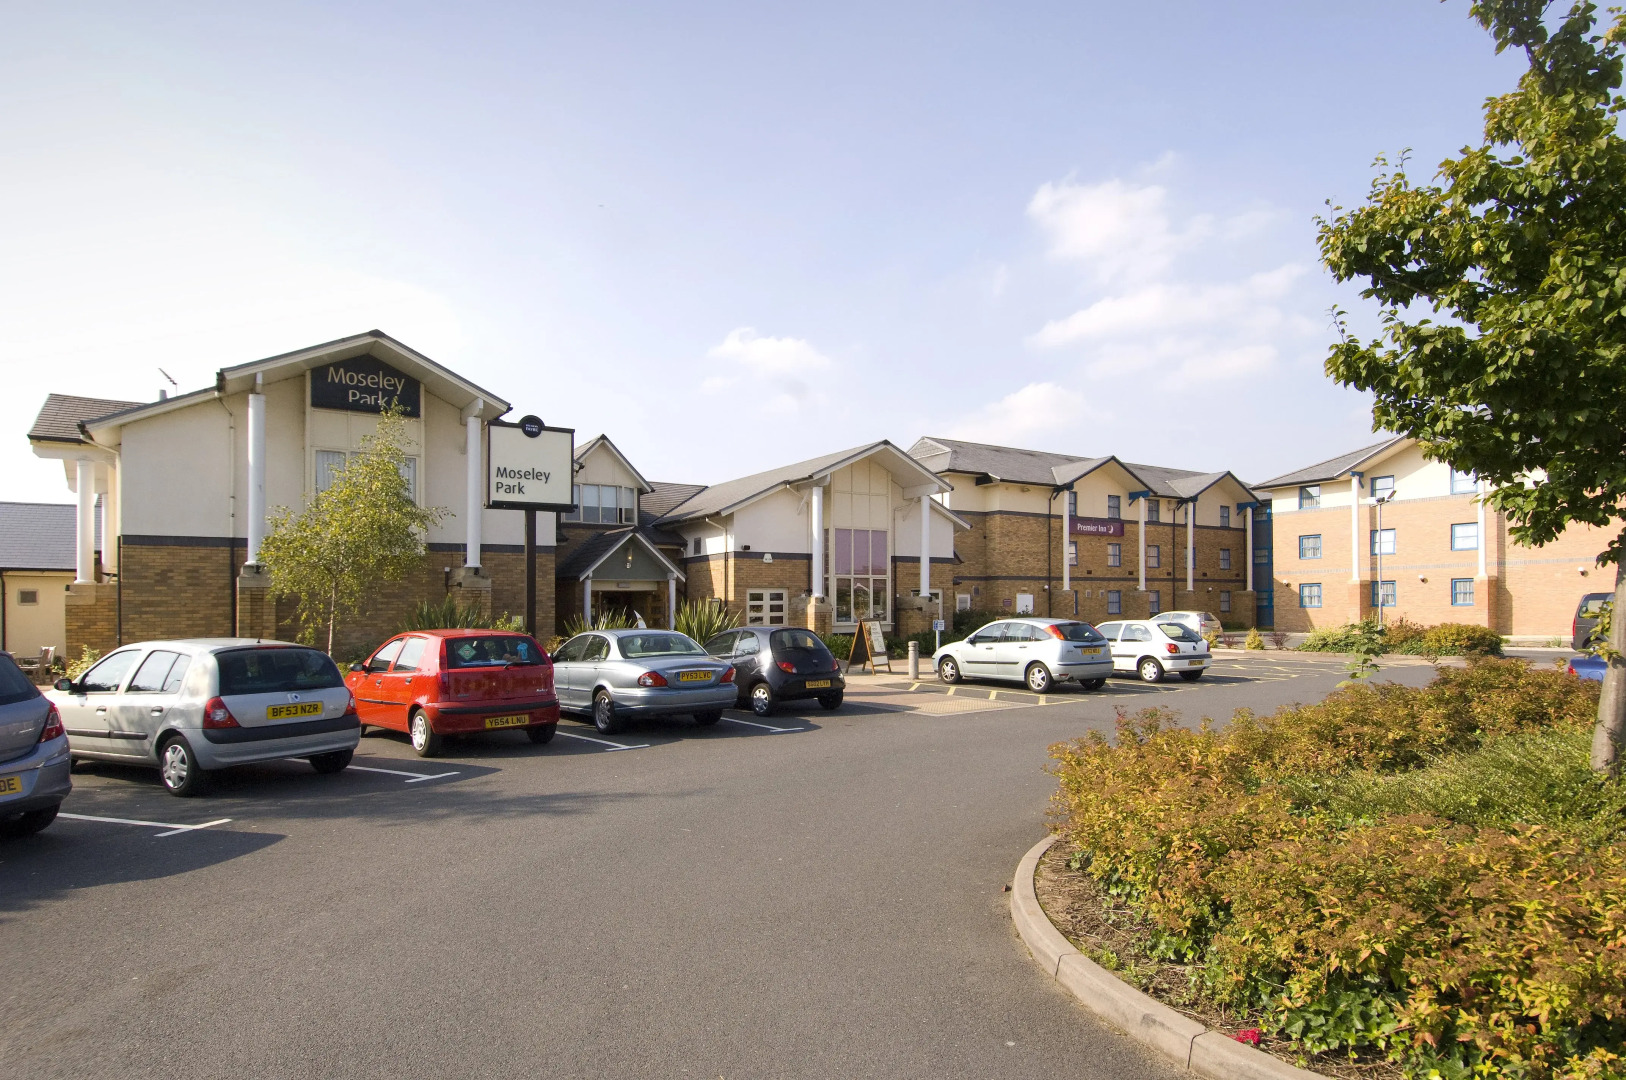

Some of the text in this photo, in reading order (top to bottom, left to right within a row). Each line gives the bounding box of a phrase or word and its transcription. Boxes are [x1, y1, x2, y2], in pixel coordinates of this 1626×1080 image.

[328, 366, 405, 394] Moseley
[348, 389, 389, 407] Park
[496, 466, 550, 484] Moseley
[496, 481, 525, 494] Park
[1077, 523, 1097, 531] Premier
[681, 671, 711, 680] PY53 LVC
[272, 704, 319, 717] BF53 NZR
[488, 717, 526, 727] Y654 LNU
